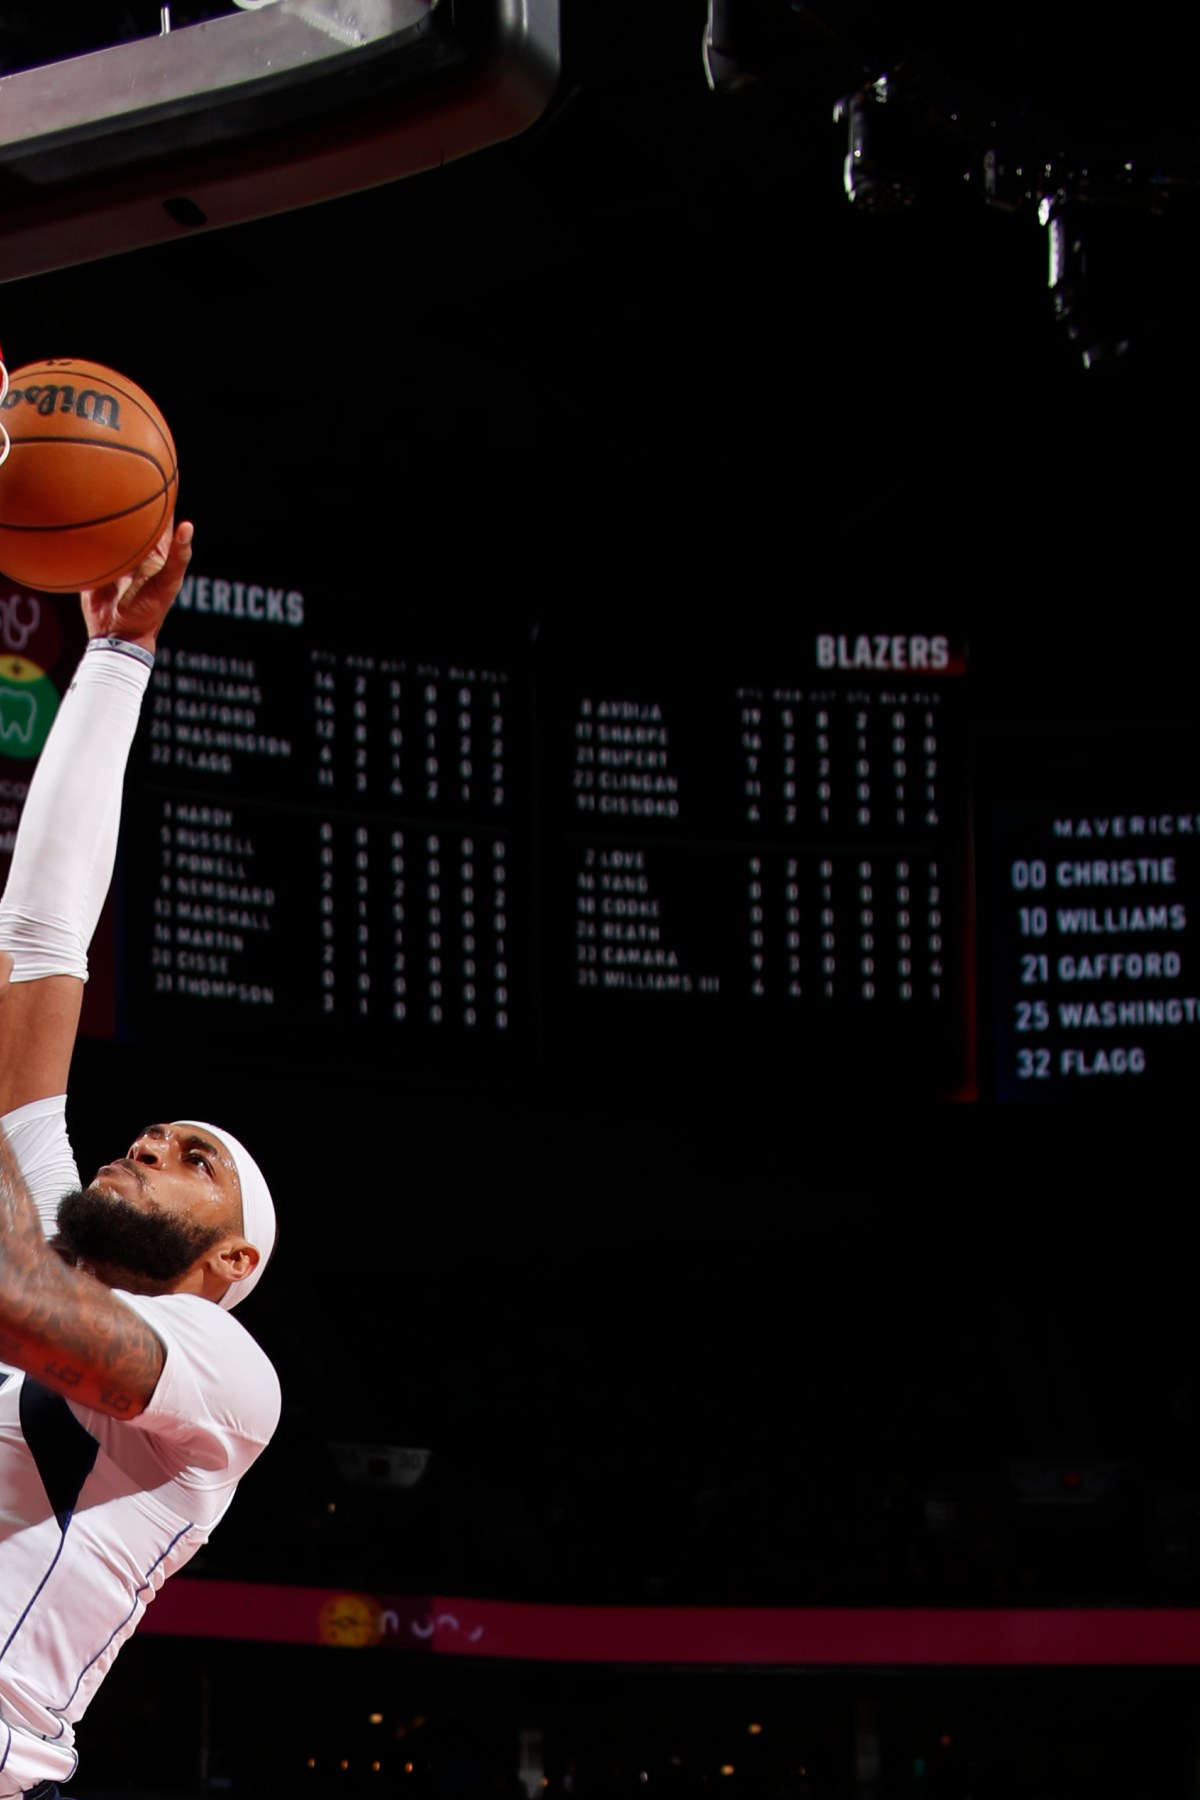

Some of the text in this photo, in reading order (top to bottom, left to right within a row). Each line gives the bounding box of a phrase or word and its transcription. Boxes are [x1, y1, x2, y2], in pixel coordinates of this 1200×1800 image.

[1, 385, 122, 431] Wilso
[176, 574, 305, 628] VERICKS
[174, 649, 255, 680] CHRISTIE
[815, 633, 950, 671] BLAZERS
[175, 675, 263, 705] WILLIAMS
[174, 698, 257, 728] GAFFORD
[175, 724, 292, 757] WASHINGTON
[597, 723, 668, 746] SHARPE
[175, 747, 233, 774] FLAGG
[598, 747, 669, 768] RUPERT
[598, 770, 680, 793] CLINGAN
[175, 804, 234, 828] HARDY
[176, 827, 254, 856] RUSSELL
[600, 849, 645, 870] LOVE
[1011, 856, 1177, 891] 00 CHRISTIE
[1017, 903, 1187, 938] 10 WILLIAMS
[176, 926, 245, 952] MARTIN
[601, 944, 680, 968] CAMARA
[1021, 951, 1182, 985] 21 GAFFORD
[177, 974, 275, 1004] THOMPSON
[602, 970, 694, 992] WILLIAMS
[1014, 997, 1200, 1033] 25 WASHINGT
[1017, 1047, 1146, 1079] 32 FLAGG
